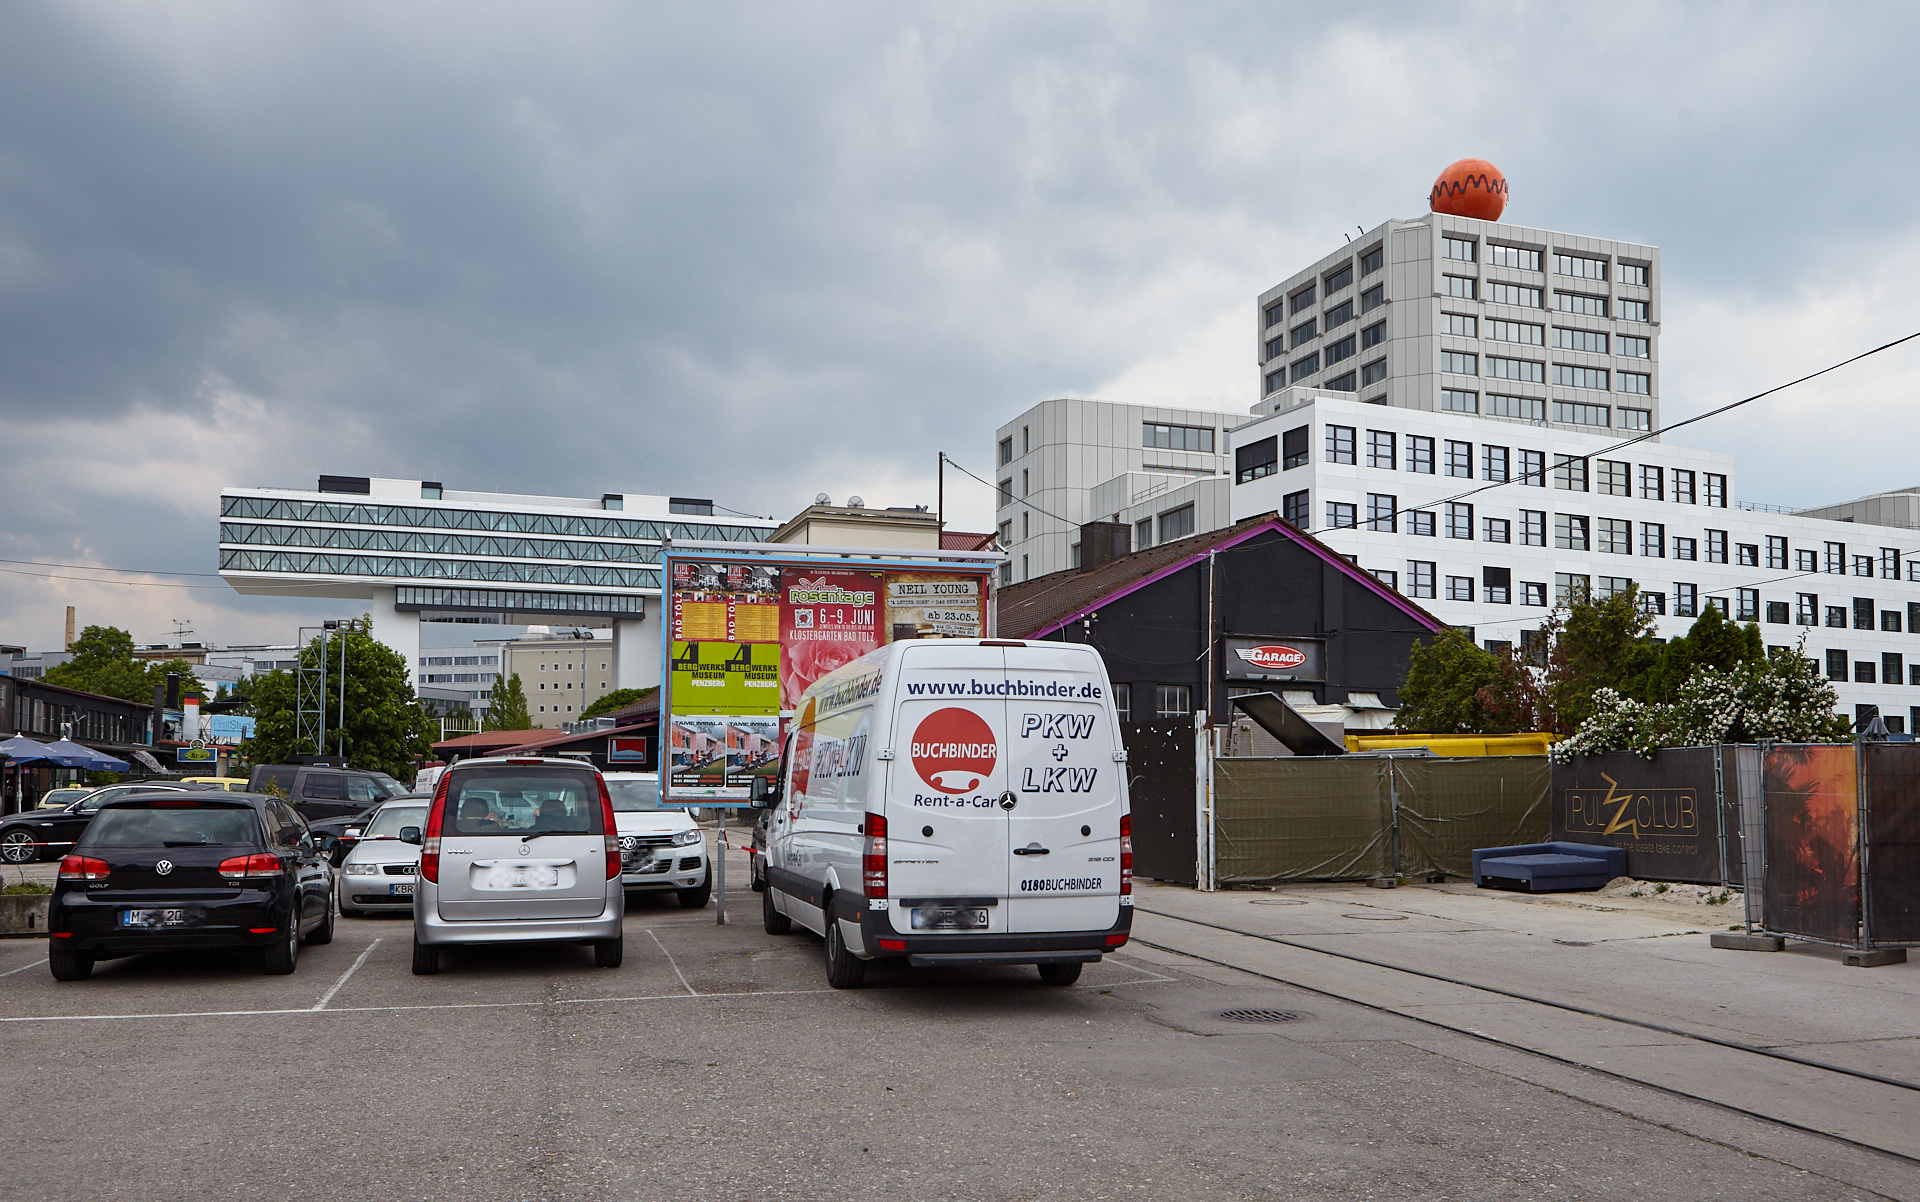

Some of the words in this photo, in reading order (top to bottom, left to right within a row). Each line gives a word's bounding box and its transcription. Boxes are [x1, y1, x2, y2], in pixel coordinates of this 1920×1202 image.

[899, 585, 927, 594] NEIL
[932, 584, 969, 594] YOUNG
[675, 592, 683, 617] TÖLZ
[790, 588, 874, 607] rosentage
[728, 594, 736, 618] TÖLZ
[850, 609, 875, 625] JUNI
[928, 611, 940, 619] ab
[944, 611, 975, 622] 23.05.
[675, 619, 683, 639] BAD
[728, 621, 736, 641] BAD
[789, 630, 842, 641] KLOSTERGARTEN
[843, 631, 857, 642] BAD
[1252, 649, 1302, 663] GARAGE
[692, 671, 725, 679] MUSEUM
[744, 672, 778, 680] MUSEUM
[744, 680, 778, 688] PENZBERG
[818, 668, 883, 713] www.buchbinder.de
[907, 679, 1102, 699] www.buchbinder.de
[1021, 713, 1096, 739] PKW
[911, 742, 997, 759] BUCHBINDER
[1052, 743, 1068, 761] +
[1021, 767, 1098, 793] LKW
[913, 793, 997, 808] Rent-a-Car
[1635, 842, 1655, 853] beatz
[1655, 843, 1671, 854] take
[1672, 843, 1699, 855] control
[395, 885, 414, 894] KBR
[1021, 877, 1102, 892] 0180BUCHBINDER
